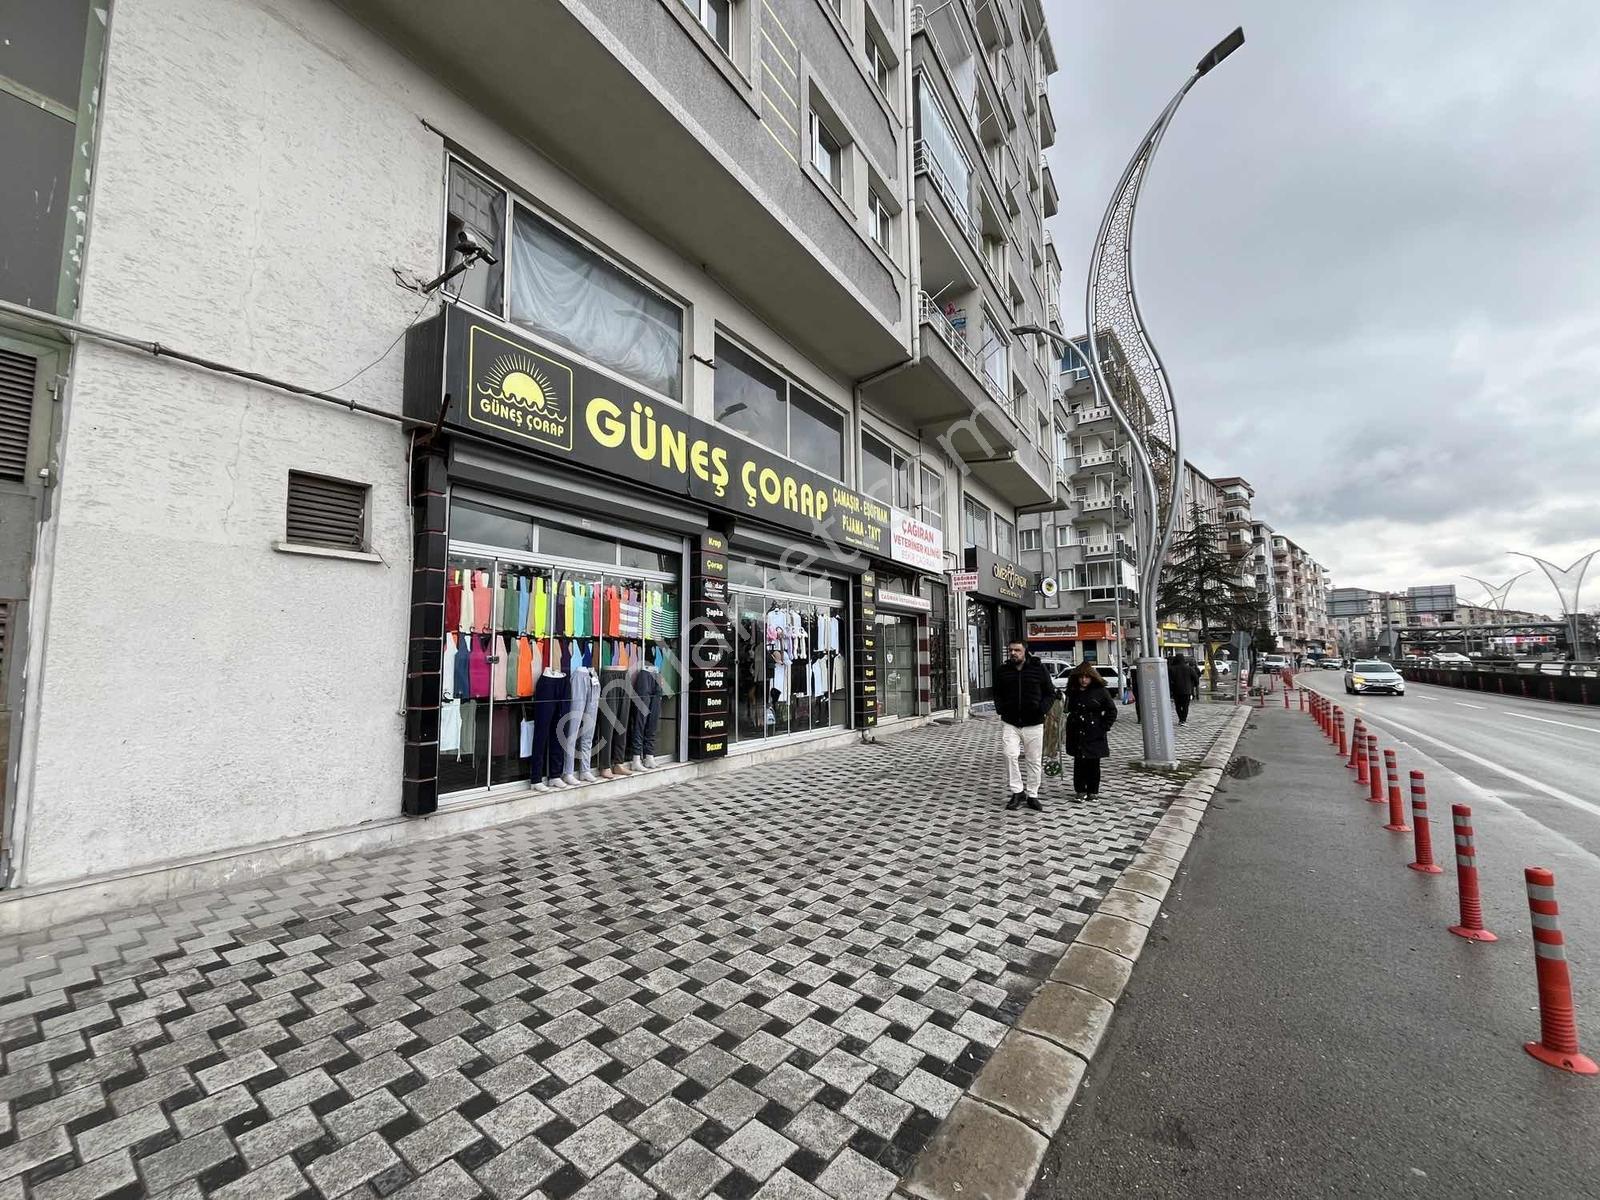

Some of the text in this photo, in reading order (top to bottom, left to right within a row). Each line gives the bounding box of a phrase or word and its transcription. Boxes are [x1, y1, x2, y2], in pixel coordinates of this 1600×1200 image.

[480, 398, 565, 437] GÜNEŞ ÇORAP
[585, 397, 829, 520] GÜNEŞ ÇORAP
[832, 487, 860, 514] ÇAMAŞIR
[863, 501, 888, 523] EŞOFMAN
[842, 515, 865, 537] PİJAMA
[867, 524, 881, 542] TAYT
[901, 519, 934, 543] ÇAĞIRAN
[708, 537, 722, 548] Krop
[706, 560, 723, 571] Çorap
[705, 607, 723, 617] Şapka
[704, 631, 725, 640] Eldiven
[708, 652, 722, 662] Tayt
[706, 679, 723, 688] Çorap
[707, 698, 722, 706] Bone
[704, 720, 724, 729] Pijama
[706, 743, 723, 752] Boxer
